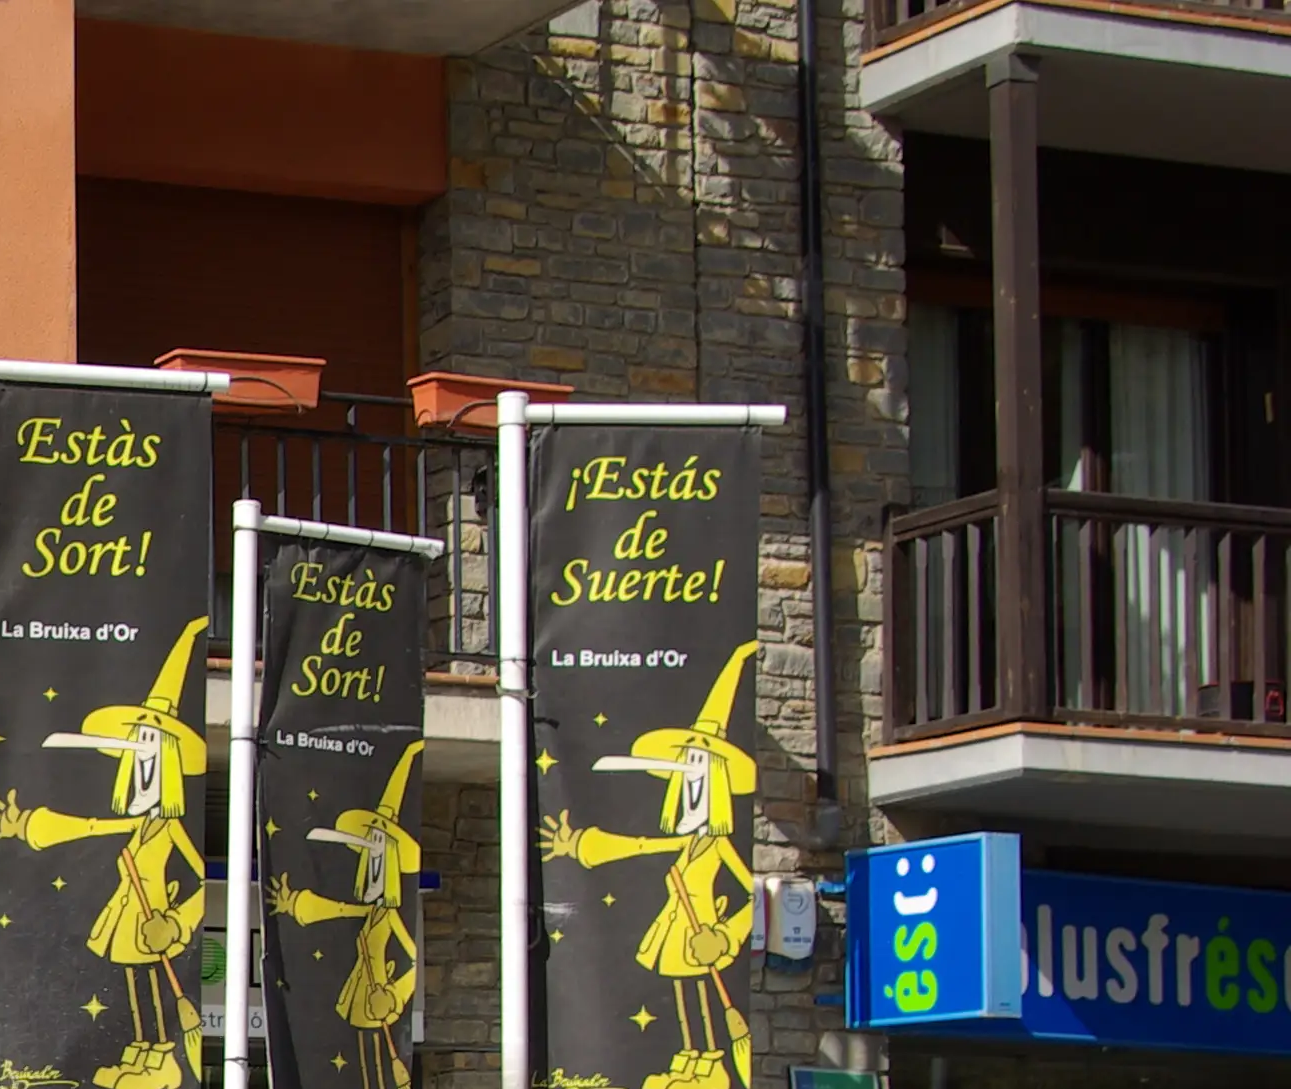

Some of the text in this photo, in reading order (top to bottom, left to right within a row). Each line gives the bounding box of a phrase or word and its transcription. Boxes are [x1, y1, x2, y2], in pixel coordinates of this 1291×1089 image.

[17, 417, 161, 468] Estàs
[60, 473, 117, 527] de
[565, 455, 721, 511] ¡Estás
[21, 527, 152, 578] Sort!
[614, 510, 668, 560] de
[290, 562, 396, 612] Estàs
[551, 559, 725, 607] Suerte!
[1, 620, 139, 642] La Bruixa d'Or
[321, 613, 363, 657] de
[291, 655, 387, 704] Sort!
[551, 650, 688, 667] La Bruixa d'Or
[276, 730, 376, 757] La Bruixa d'Or
[1020, 903, 1291, 1014] lusfrés
